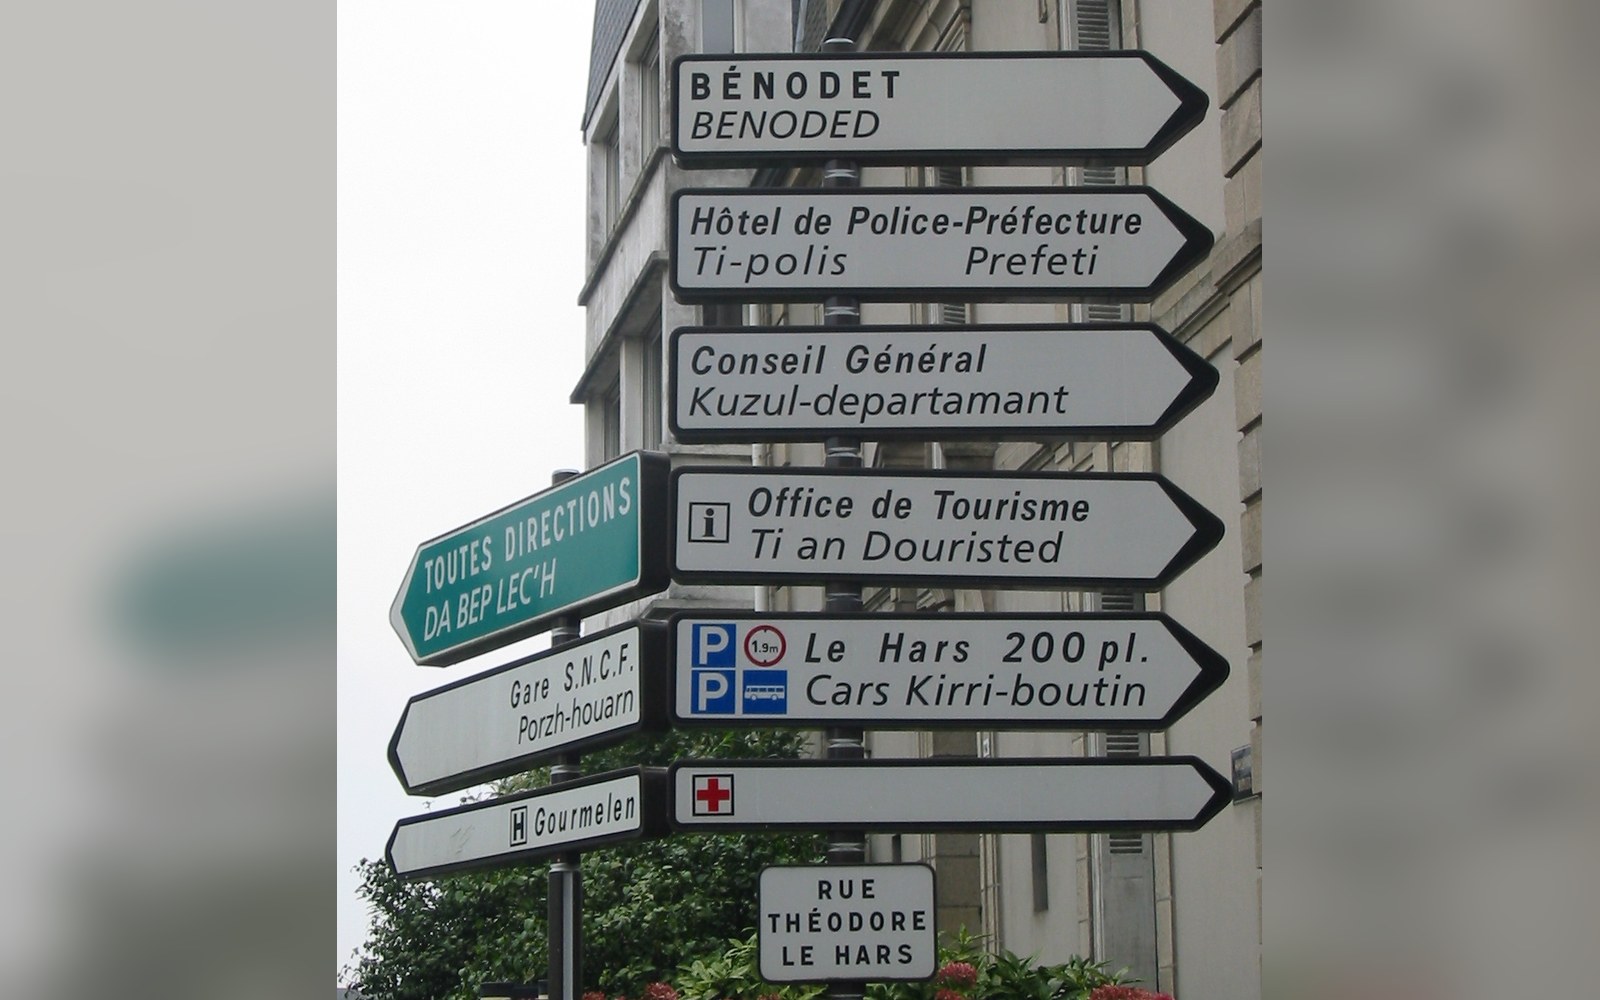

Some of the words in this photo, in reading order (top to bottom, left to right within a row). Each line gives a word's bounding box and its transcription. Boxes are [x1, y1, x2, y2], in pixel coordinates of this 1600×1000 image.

[690, 66, 901, 100] BÉNODET
[690, 110, 881, 140] BENODED
[690, 206, 782, 236] Hôtel
[794, 207, 832, 236] de
[847, 205, 1142, 236] Police-Préfecture
[693, 244, 848, 284] Ti-polis
[965, 244, 1100, 277] Prefeti
[691, 344, 827, 375] Conseil
[846, 343, 988, 374] Général
[688, 384, 1070, 424] Kuzul-departamant
[748, 486, 854, 520] Office
[872, 489, 912, 521] de
[933, 490, 1091, 523] Tourisme
[424, 535, 492, 594] TOUTES
[505, 476, 631, 562] DIRECTIONS
[750, 527, 784, 561] Ti
[797, 535, 845, 562] an
[862, 530, 1064, 564] Douristed
[424, 599, 451, 641] DA
[456, 583, 493, 630] BEP
[496, 558, 558, 615] LEC'H
[699, 625, 730, 665] P
[752, 640, 779, 653] 1.9m
[805, 632, 846, 664] Le
[880, 632, 970, 664] Hars
[1002, 631, 1086, 664] 200
[1099, 632, 1149, 672] pl.
[510, 674, 549, 709] Gare
[563, 642, 635, 693] S.N.C.F.
[698, 672, 729, 711] P
[806, 673, 890, 707] Cars
[905, 673, 1147, 707] Kirri-boutin
[518, 688, 635, 745] Porzh-houarn
[512, 810, 526, 843] H
[534, 792, 636, 837] Gourmelen
[818, 879, 875, 900] RUE
[768, 908, 926, 933] THÉODORE
[782, 946, 814, 966] LE
[835, 944, 913, 965] HARS
